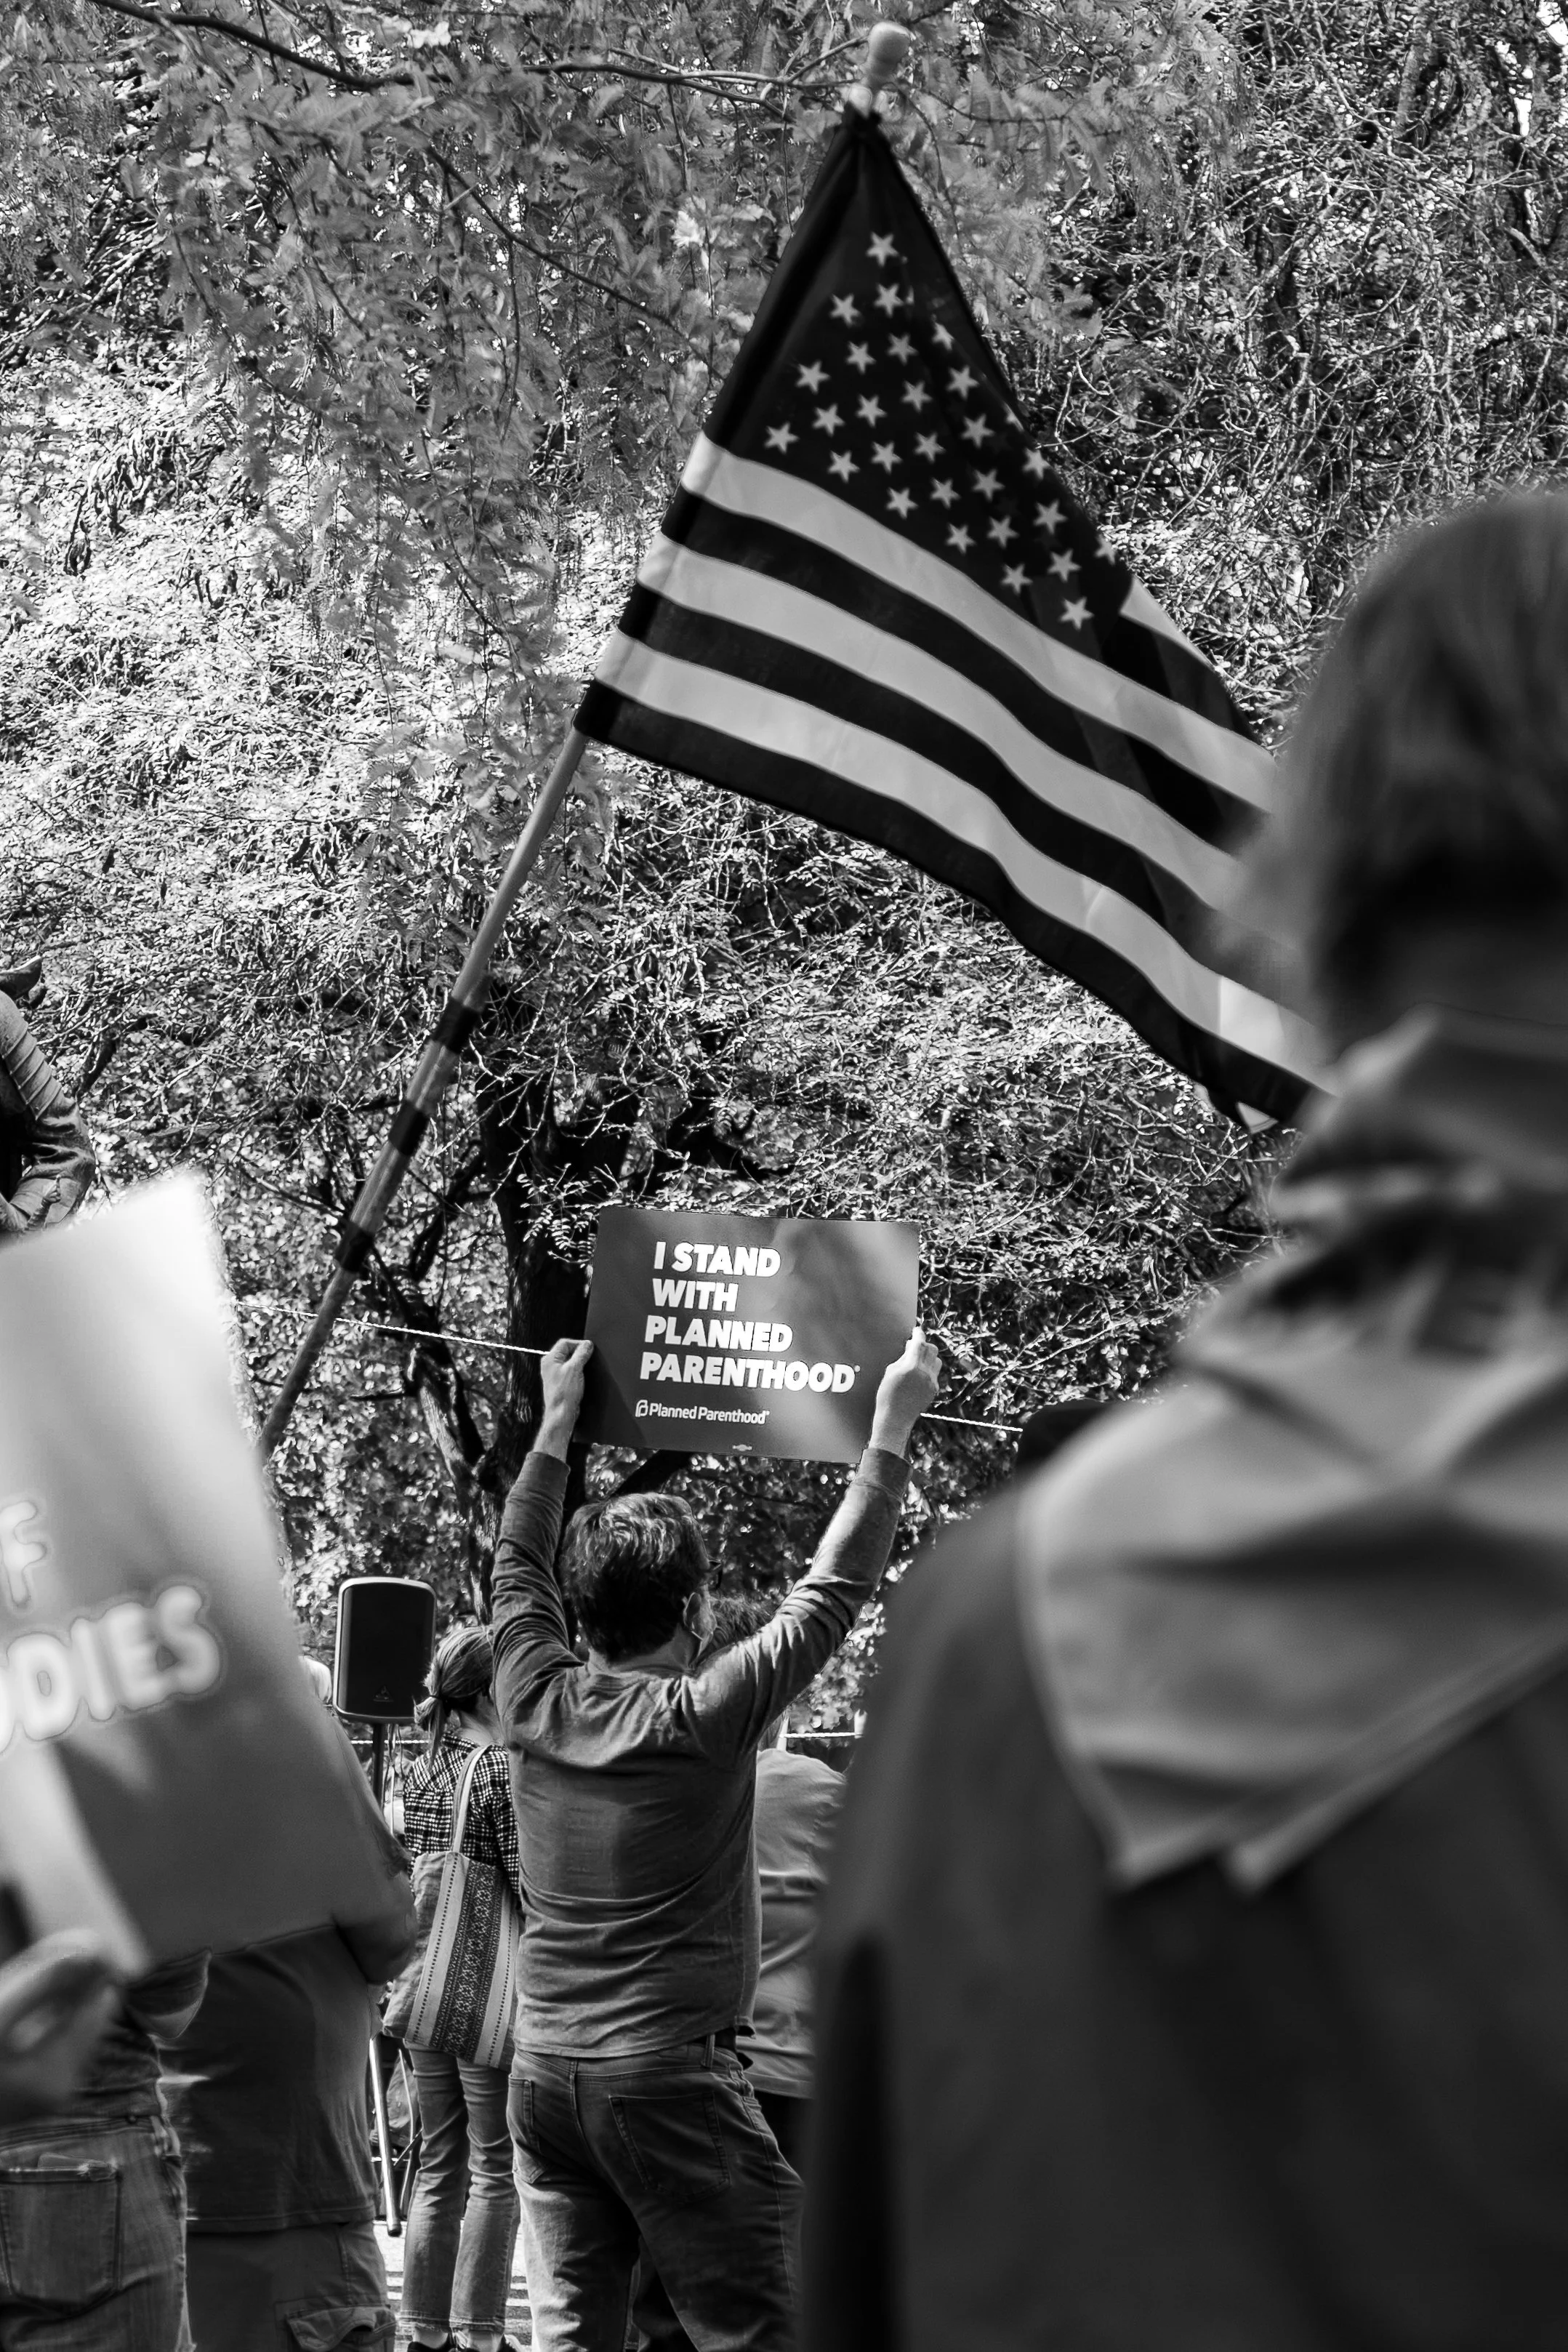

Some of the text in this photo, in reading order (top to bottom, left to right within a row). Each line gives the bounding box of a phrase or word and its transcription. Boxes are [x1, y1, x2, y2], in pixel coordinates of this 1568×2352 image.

[654, 1241, 781, 1277] I STAND
[653, 1278, 739, 1312] WITH
[644, 1315, 793, 1352] PLANNED
[640, 1352, 856, 1394] PARENTHOOD
[649, 1403, 766, 1425] Planned Parenthood
[0, 1585, 220, 1754] DIES
